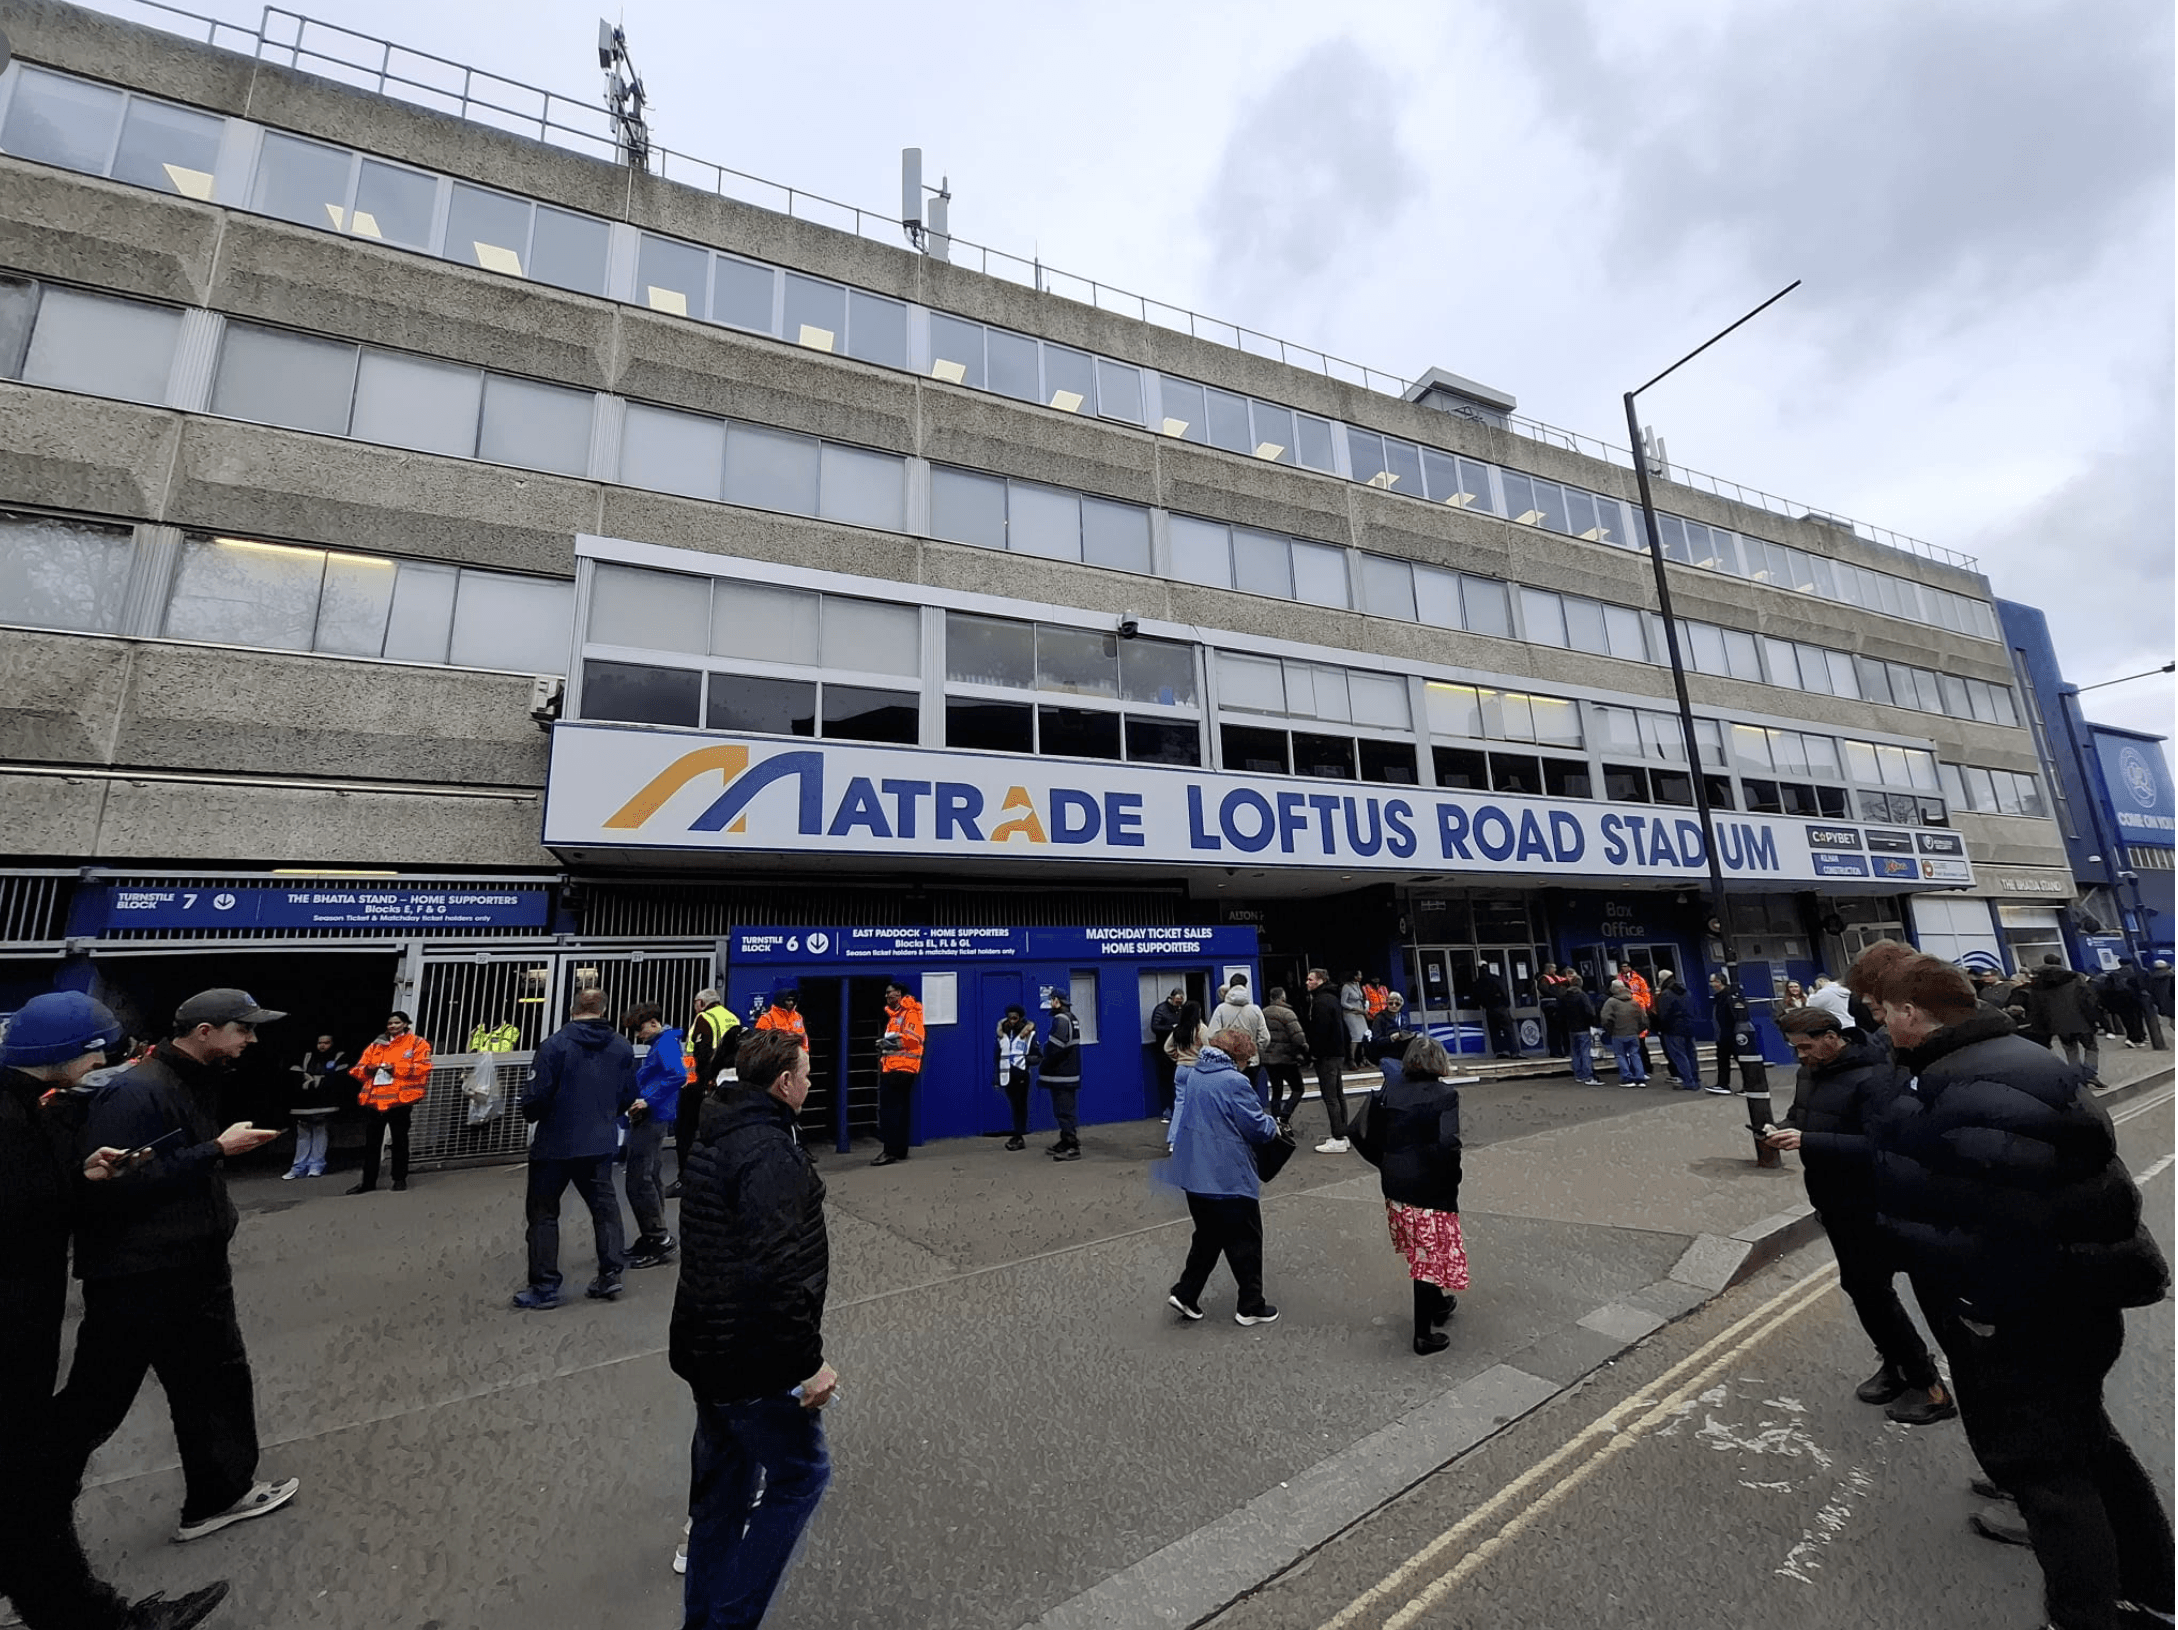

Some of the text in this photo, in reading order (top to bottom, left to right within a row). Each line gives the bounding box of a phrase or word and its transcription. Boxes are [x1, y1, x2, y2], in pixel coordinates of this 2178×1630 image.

[601, 744, 1145, 847] MATRADE
[1187, 785, 1780, 871] LOFTUS ROAD STADUM
[116, 901, 157, 909] BLOCK
[118, 893, 198, 909] TURNSTILE 7
[288, 894, 310, 904] THE
[313, 894, 355, 904] BHATIA
[358, 895, 397, 904] STAND
[410, 895, 446, 904] HOME
[448, 895, 518, 905] SUPPORTERS
[365, 904, 447, 915] Blocks E, F & G
[1606, 901, 1633, 917] Box
[346, 914, 369, 922] Ticket
[380, 915, 420, 923] Matchday
[475, 915, 491, 923] only
[853, 929, 873, 937] EAST
[875, 928, 920, 937] PADDOCK
[930, 929, 956, 937] HOME
[958, 928, 1009, 937] SUPPORTERS
[1086, 928, 1213, 940] MATCHDAY TICKET SALES
[1601, 921, 1645, 938] Office
[741, 936, 799, 951] TURNSTILE 6
[741, 944, 771, 952] BLOCK
[895, 939, 923, 948] Blocks
[940, 939, 949, 947] FL
[951, 939, 957, 947] &
[959, 939, 971, 947] GL
[1102, 942, 1200, 954] HOME SUPPORTERS
[925, 949, 958, 957] matchday
[1002, 948, 1015, 956] only
